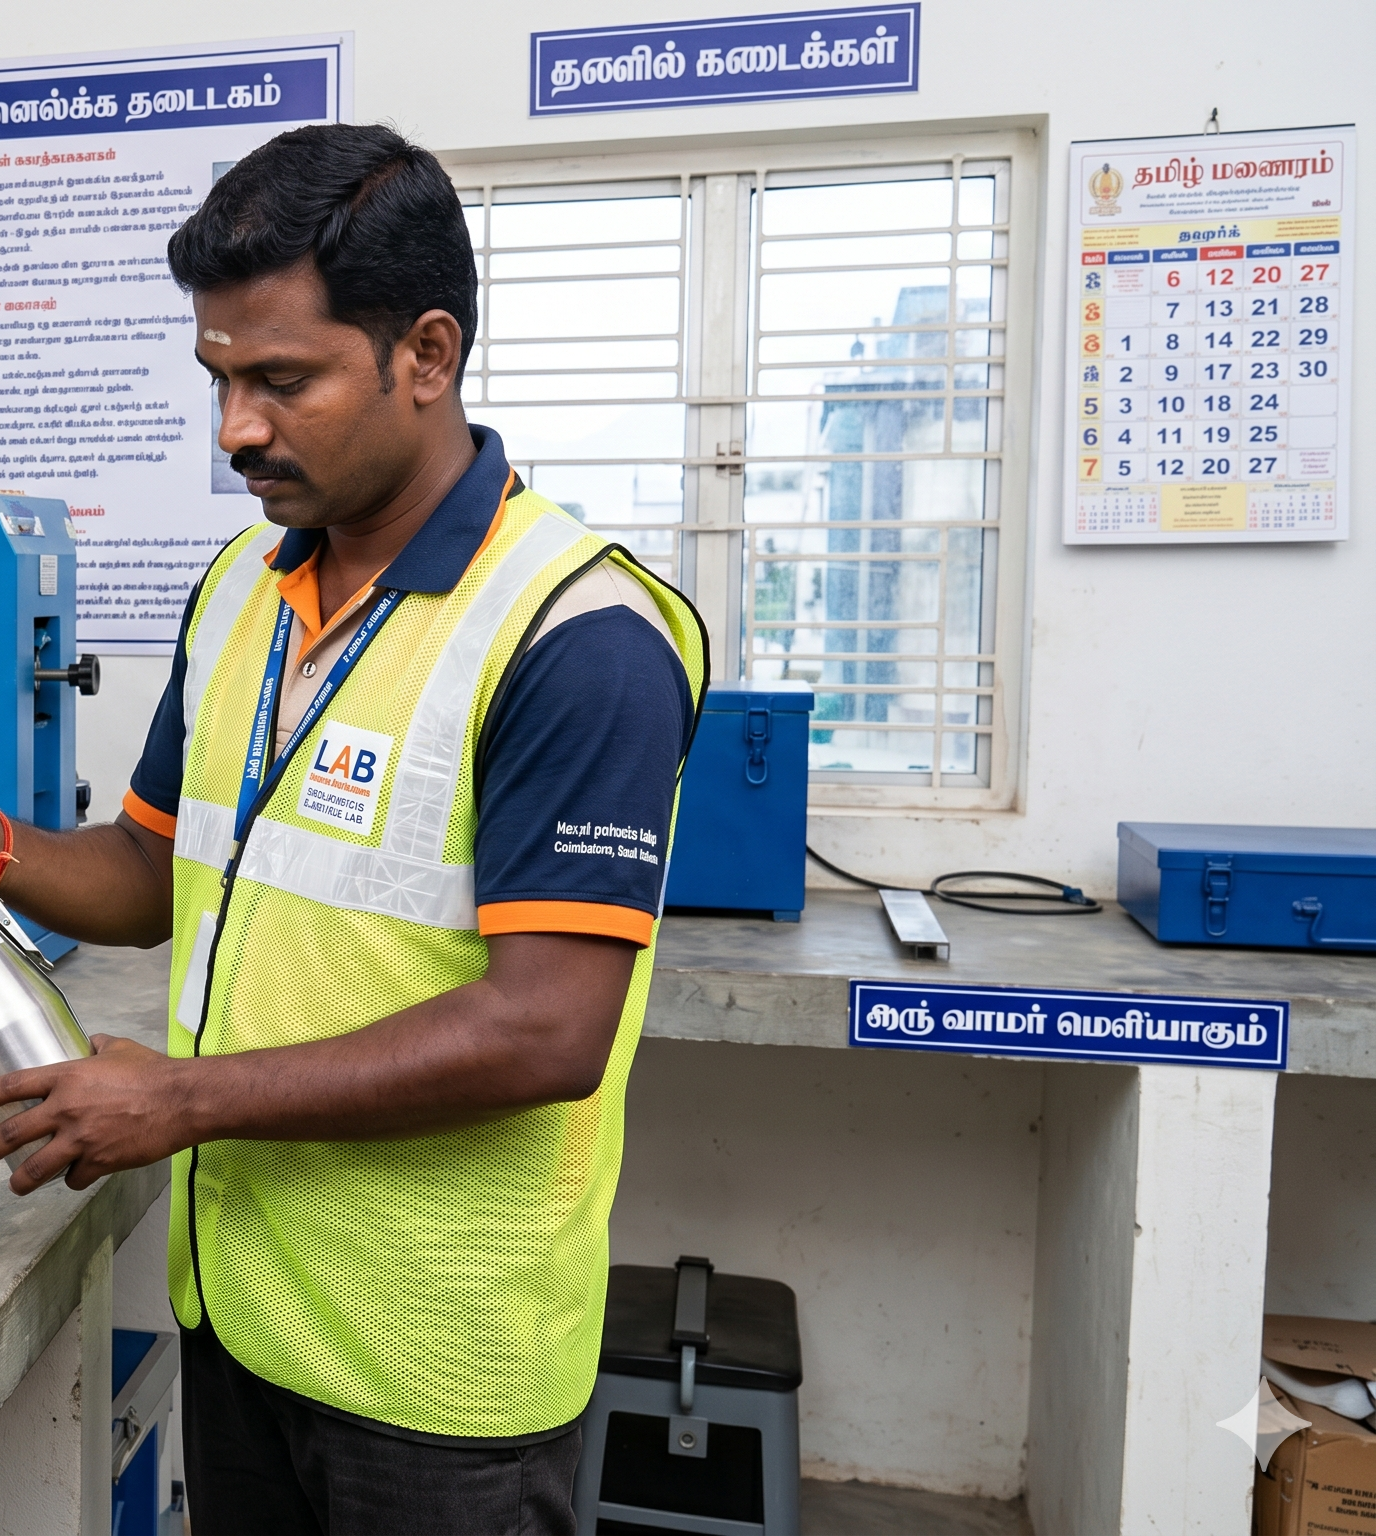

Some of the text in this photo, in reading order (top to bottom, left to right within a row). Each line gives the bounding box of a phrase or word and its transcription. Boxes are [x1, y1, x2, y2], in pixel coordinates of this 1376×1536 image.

[1132, 157, 1203, 189] தமிழ்
[1167, 264, 1330, 287] 6 12 20 27
[1166, 296, 1328, 318] 7 13 21 28
[1120, 328, 1328, 351] 1 8 14 22 29
[1119, 360, 1328, 383] 2 9 17 23 30
[1083, 394, 1279, 415] 5 3 10 18 24
[1083, 426, 1278, 446] 6 4 11 19 25
[1083, 457, 1277, 477] 7 5 12 20 27
[313, 739, 376, 783] LAB
[943, 1003, 1048, 1034] வாமர்
